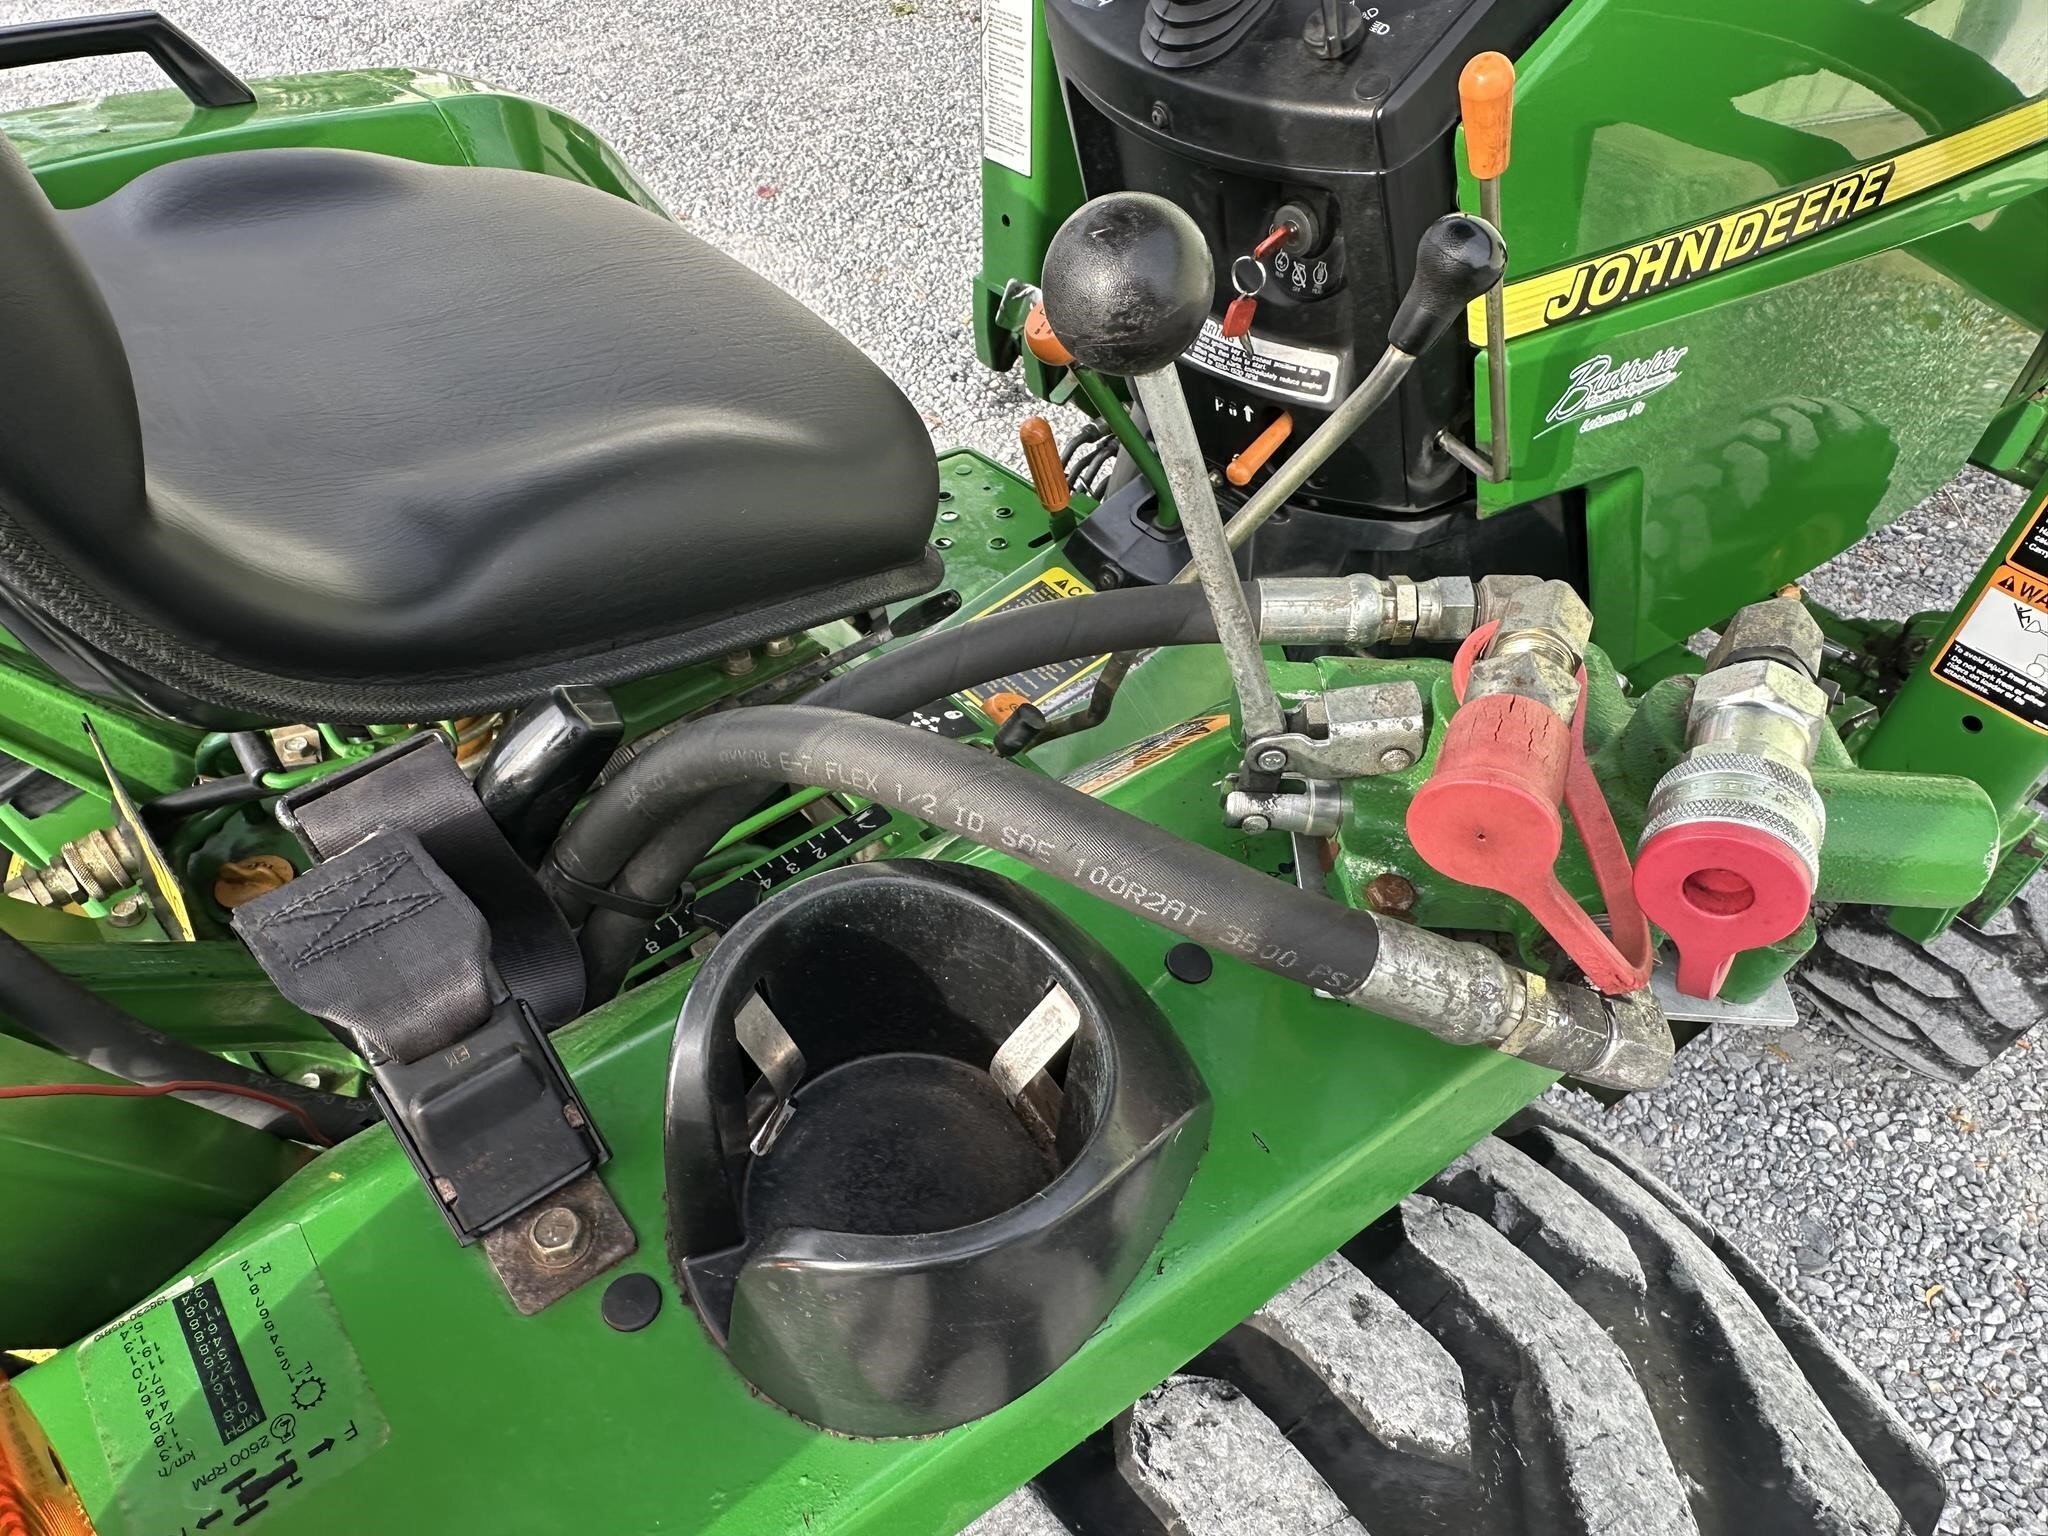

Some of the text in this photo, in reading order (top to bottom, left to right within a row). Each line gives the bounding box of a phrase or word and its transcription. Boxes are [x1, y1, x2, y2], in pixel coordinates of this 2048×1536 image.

[1545, 160, 1895, 325] JOHN DEERE
[1951, 655, 1962, 664] Do
[1962, 662, 1976, 672] not
[1976, 669, 1995, 681] work
[1954, 644, 1963, 653] To
[1963, 651, 1984, 664] avoid
[1984, 661, 2007, 676] injury
[812, 847, 827, 860] 2
[841, 834, 853, 845] 1
[786, 862, 800, 874] 3
[825, 761, 879, 793] FLEX
[895, 784, 938, 815] 1/2
[954, 806, 984, 833] ID
[1000, 824, 1056, 863] SAE
[1073, 858, 1207, 927] 100R2AT
[1218, 924, 1298, 968] 3500
[760, 878, 771, 889] 4
[645, 941, 660, 954] 8
[677, 925, 690, 938] 7
[247, 1262, 272, 1282] R-1
[119, 1260, 250, 1341] 2 3.4 5.4
[130, 1284, 260, 1366] 8 11.8 19.1
[132, 1297, 264, 1379] 7 6.8 11.0
[123, 1335, 146, 1354] 1.3
[138, 1308, 270, 1393] 6 4.8 7.7
[140, 1320, 275, 1406] 5 3.5 5.6
[145, 1334, 278, 1420] 4 2.7 4.4
[287, 1361, 313, 1383] F-1
[149, 1346, 285, 1433] 3 1.6 2.5
[154, 1358, 291, 1448] 2 1.1 1.8
[158, 1411, 260, 1477] MPH km/h
[344, 1419, 358, 1441] F
[159, 1441, 183, 1462] 1.3
[192, 1435, 270, 1491] 2600 RPM
